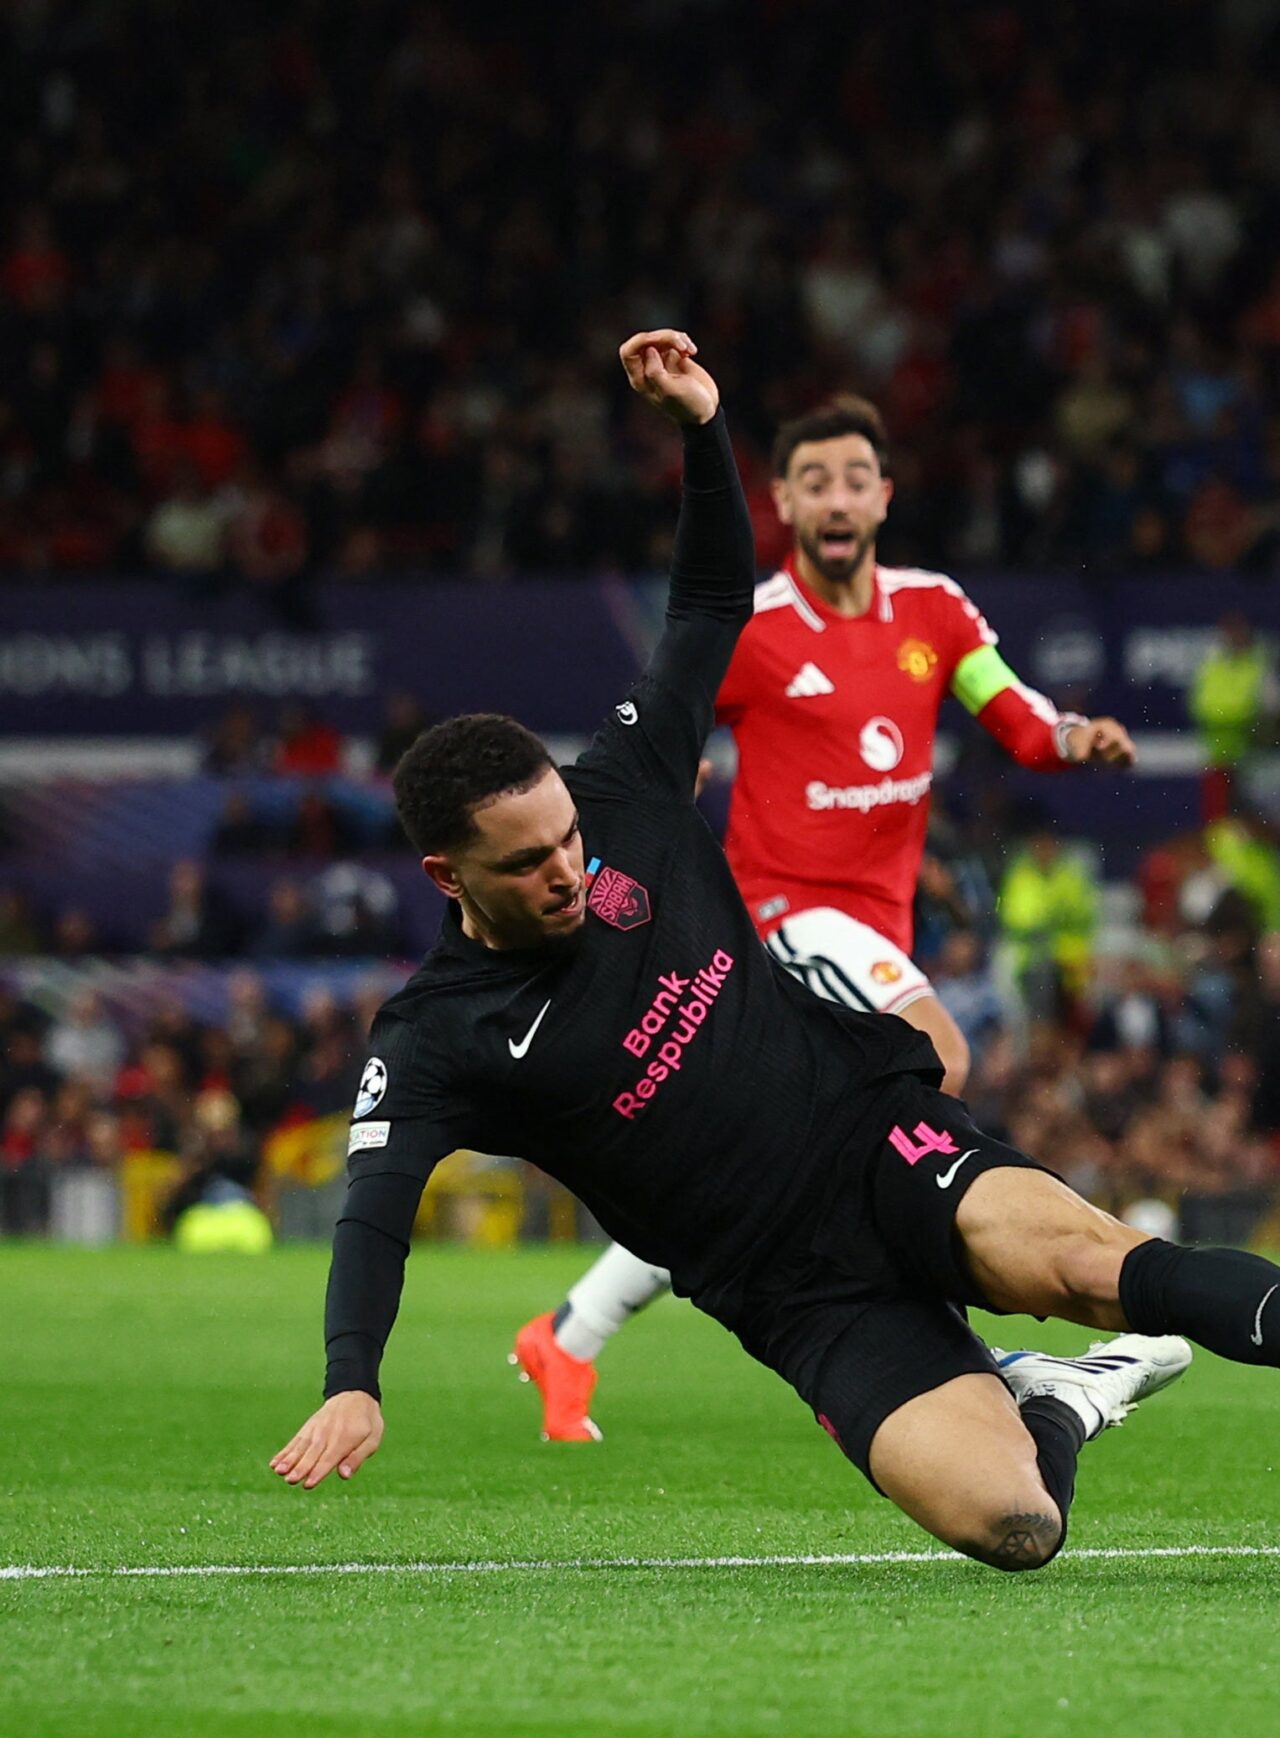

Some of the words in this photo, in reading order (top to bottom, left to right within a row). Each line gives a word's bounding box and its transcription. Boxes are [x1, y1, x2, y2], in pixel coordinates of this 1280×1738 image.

[601, 874, 634, 920] SABAH
[612, 949, 734, 1119] Respublika
[623, 971, 690, 1058] Bank
[888, 1121, 960, 1166] 4
